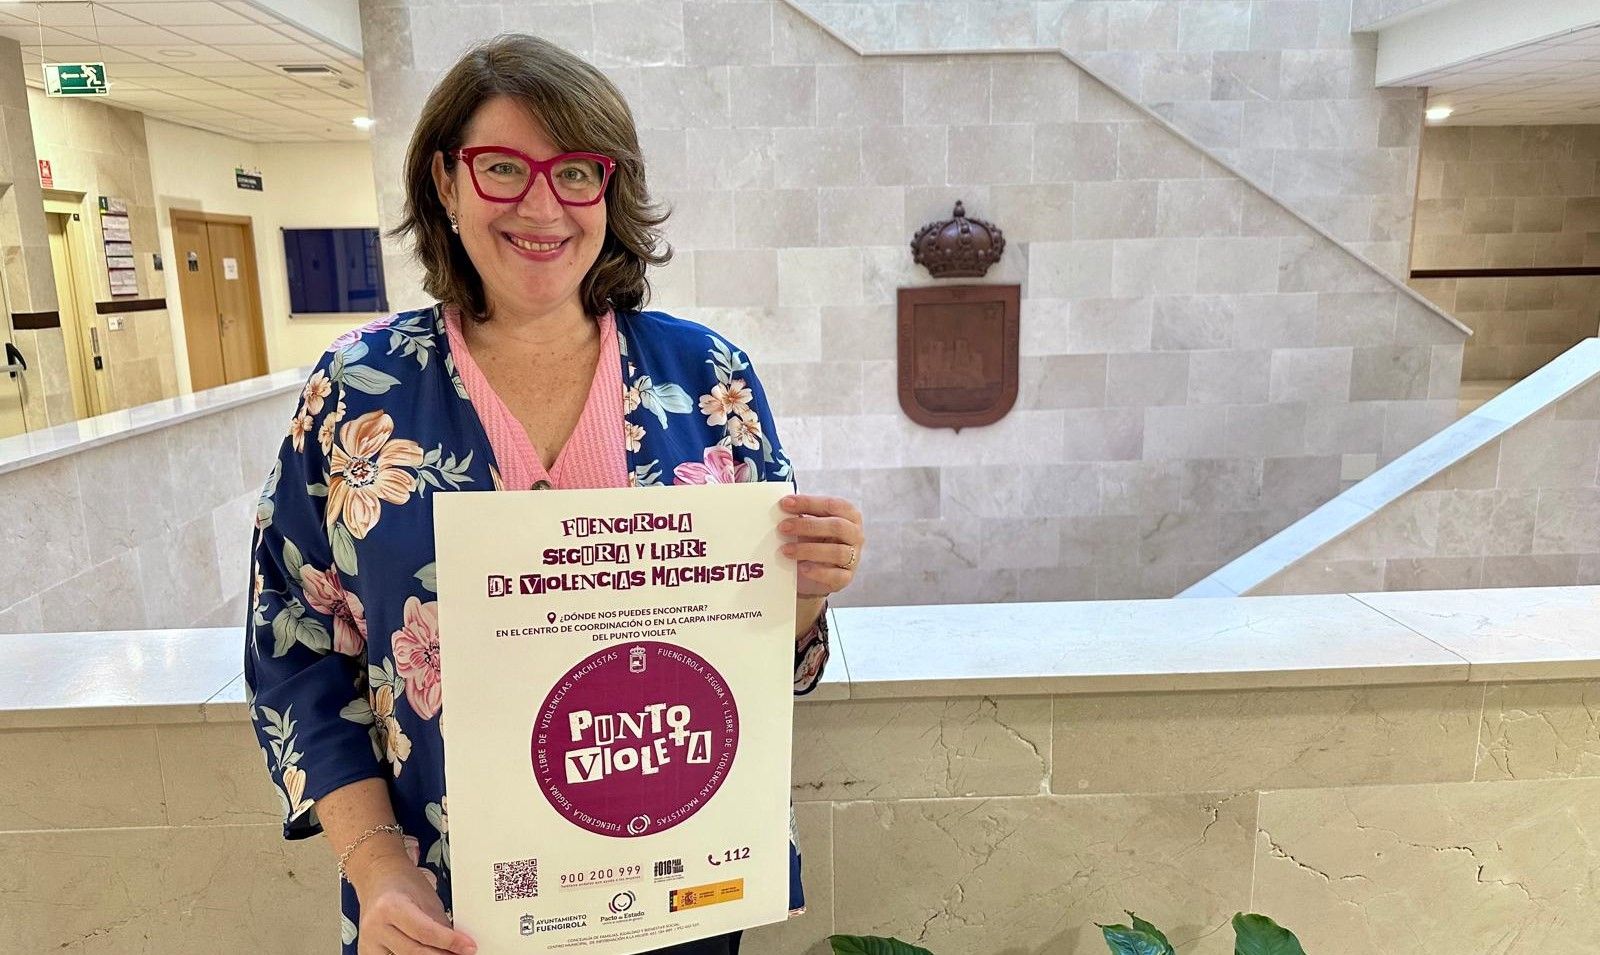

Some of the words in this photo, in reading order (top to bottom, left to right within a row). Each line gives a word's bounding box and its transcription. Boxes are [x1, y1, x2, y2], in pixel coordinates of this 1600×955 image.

[561, 513, 692, 538] FUENGIROLA
[542, 543, 630, 565] SEGURA
[636, 544, 645, 560] Y
[650, 538, 707, 561] LIBRE
[488, 575, 513, 598] DE
[519, 570, 646, 595] VIOLENCIAS
[651, 563, 764, 587] MACHISTAS
[496, 629, 509, 638] EN
[510, 628, 521, 637] EL
[522, 625, 559, 636] CENTRO
[560, 624, 573, 633] DE
[574, 619, 643, 633] COORDINACIÓN
[644, 619, 652, 627] O
[653, 618, 666, 627] EN
[667, 617, 677, 626] LA
[678, 615, 706, 625] CARPA
[707, 610, 762, 623] INFORMATIVA
[559, 609, 596, 623] ¿DÓNDE
[598, 611, 617, 620] NOS
[618, 608, 651, 618] PUEDES
[653, 604, 708, 616] ENCONTRAR?
[592, 632, 608, 642] DEL
[609, 630, 640, 641] PUNTO
[641, 628, 677, 639] VIOLETA
[572, 651, 619, 681] MACHISTAS
[657, 648, 704, 674] FUENGIROLA
[704, 673, 725, 699] SEGURA
[541, 681, 573, 729] VIOLENCIAS
[568, 703, 691, 746] PUNTO
[724, 709, 734, 733] LIBRE
[538, 733, 548, 744] DE
[725, 738, 733, 748] DE
[539, 748, 549, 774] LIBRE
[564, 730, 712, 784] VIOLETA
[700, 752, 730, 797] VIOLENCIAS
[550, 786, 573, 811] SEGURA
[573, 809, 621, 832] FUENGIROLA
[656, 798, 699, 826] MACHISTAS
[724, 847, 750, 863] 112
[560, 873, 584, 885] 900
[590, 869, 613, 881] 200
[619, 865, 641, 877] 999
[536, 914, 587, 925] AYUNTAMIENTO
[536, 921, 587, 933] FUENGIROLA
[623, 911, 645, 919] Estado
